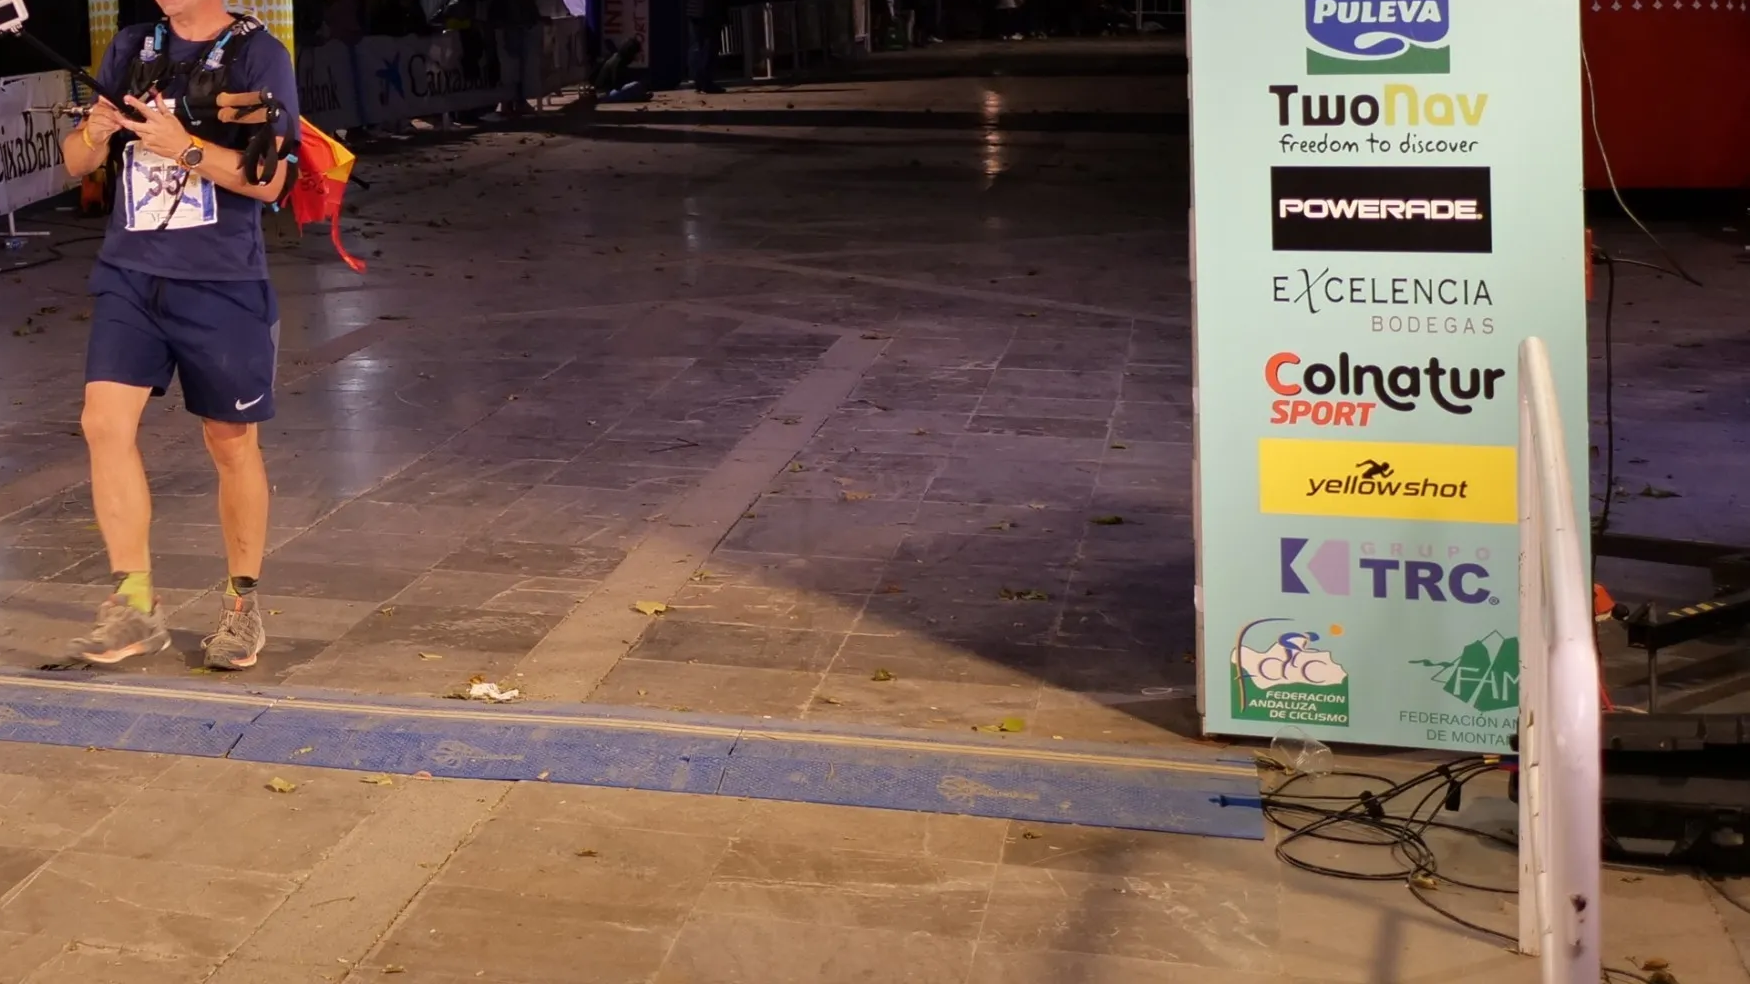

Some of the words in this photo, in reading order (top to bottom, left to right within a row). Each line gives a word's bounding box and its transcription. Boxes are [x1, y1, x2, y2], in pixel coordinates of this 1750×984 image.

[1278, 133, 1359, 154] freedom
[1366, 133, 1391, 154] to
[1399, 133, 1479, 154] discover
[1272, 267, 1494, 314] EXCELENCIA
[1371, 315, 1495, 335] BODEGAS
[1264, 351, 1506, 415] Colnatur
[1270, 399, 1376, 427] SPORT
[1360, 541, 1492, 562] GRUPO
[1248, 699, 1317, 712] ANDALUZA
[1265, 690, 1345, 704] FEDERACIÓN
[1269, 709, 1287, 719] DE
[1289, 710, 1348, 724] CICLISMO
[1400, 711, 1499, 729] FEDERACIÓN
[1426, 730, 1447, 742] DE
